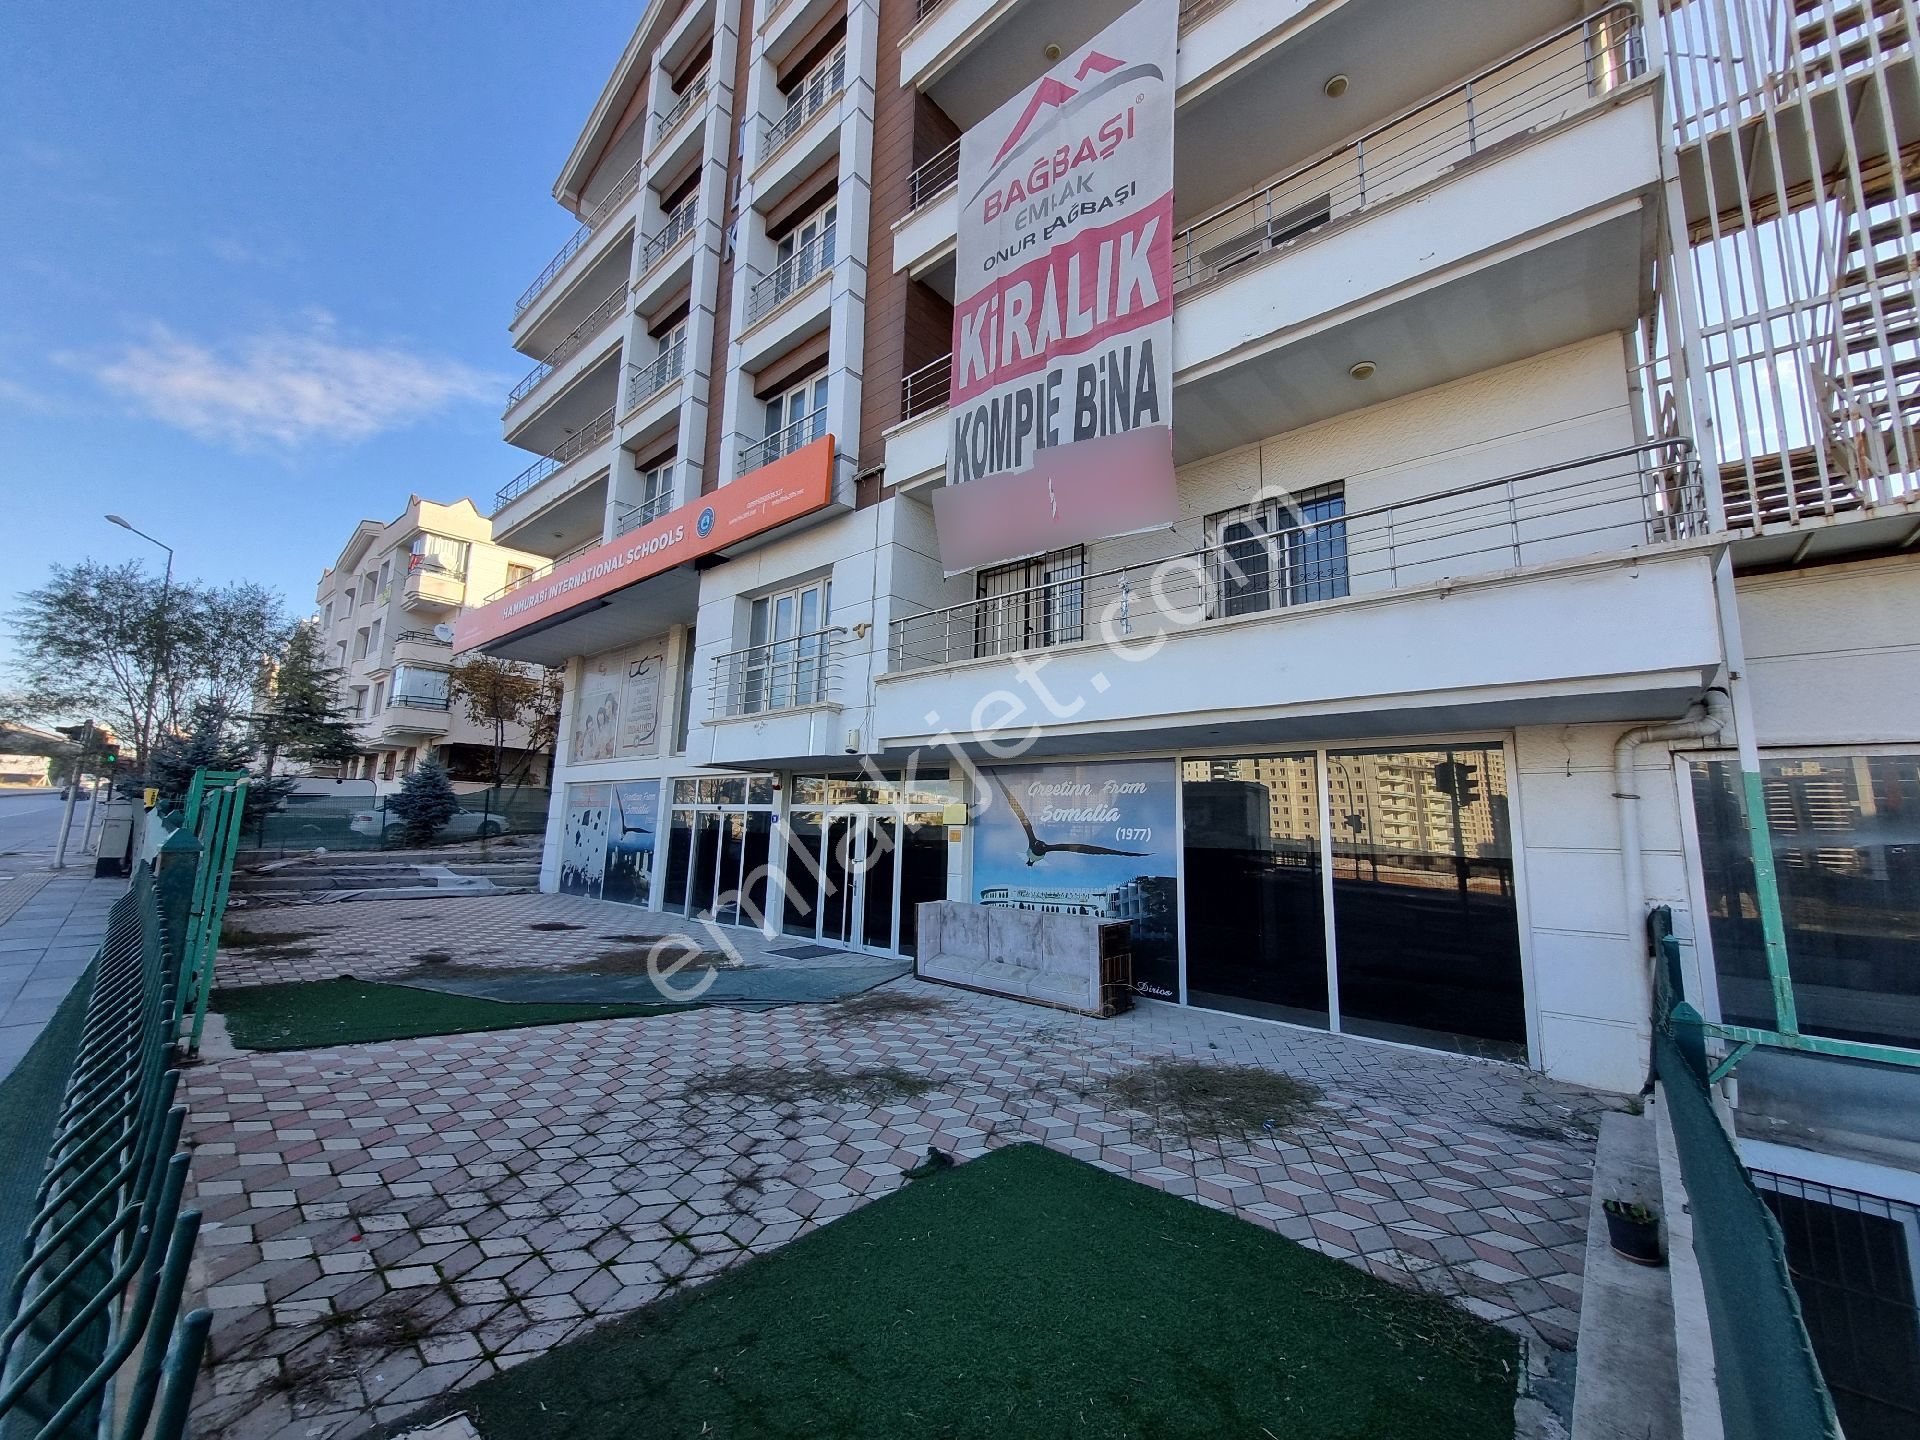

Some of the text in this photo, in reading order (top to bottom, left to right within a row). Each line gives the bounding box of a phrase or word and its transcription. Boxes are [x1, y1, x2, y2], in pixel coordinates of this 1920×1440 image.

[983, 106, 1136, 225] BAĞBAŞI
[1014, 171, 1095, 231] EMLAK
[983, 231, 1037, 272] ONUR
[548, 553, 625, 598] INTERNATIONAL
[625, 524, 685, 565] SCHOOLS
[1102, 779, 1148, 795] From
[1040, 803, 1121, 823] Somalia
[1115, 826, 1152, 843] (1977)
